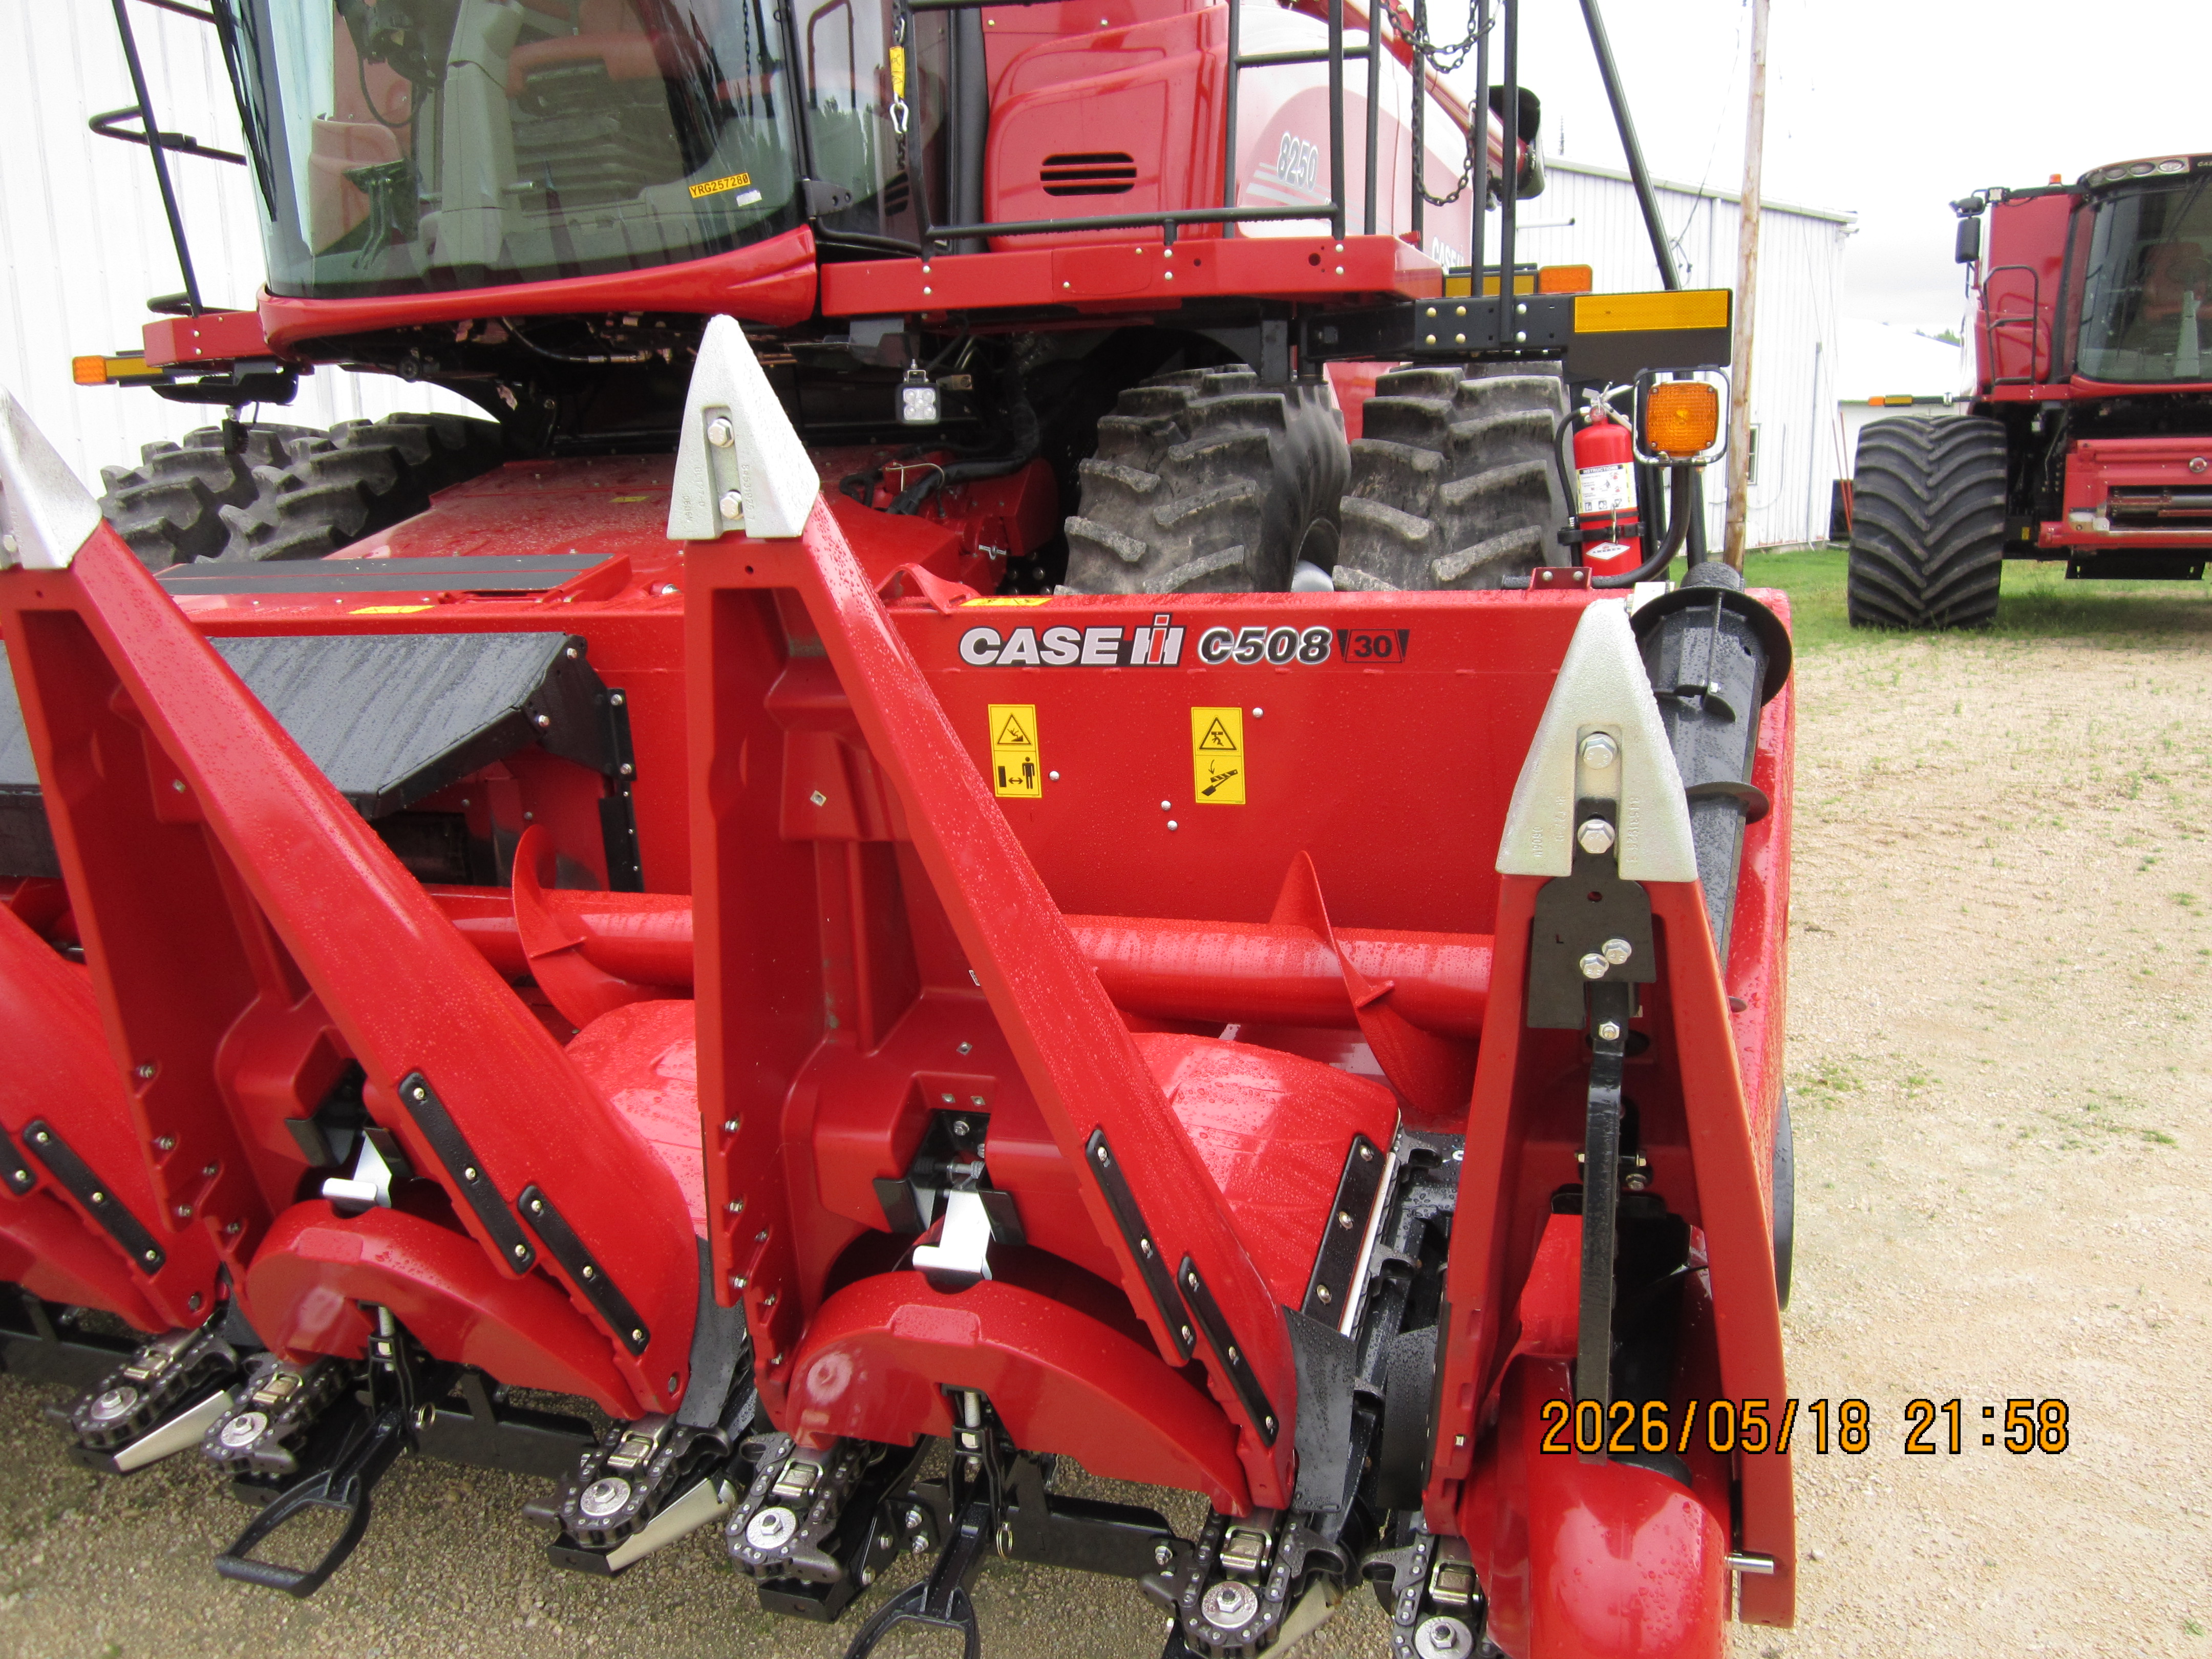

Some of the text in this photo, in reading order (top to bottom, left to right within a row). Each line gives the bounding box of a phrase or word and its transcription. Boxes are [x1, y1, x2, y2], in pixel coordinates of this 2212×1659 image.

[1277, 130, 1318, 193] 8250
[690, 174, 749, 196] YRG257280
[1583, 465, 1619, 474] INSTRUCTIONS
[960, 627, 1124, 665] CASE
[1198, 626, 1333, 665] C508
[1353, 635, 1392, 658] 30
